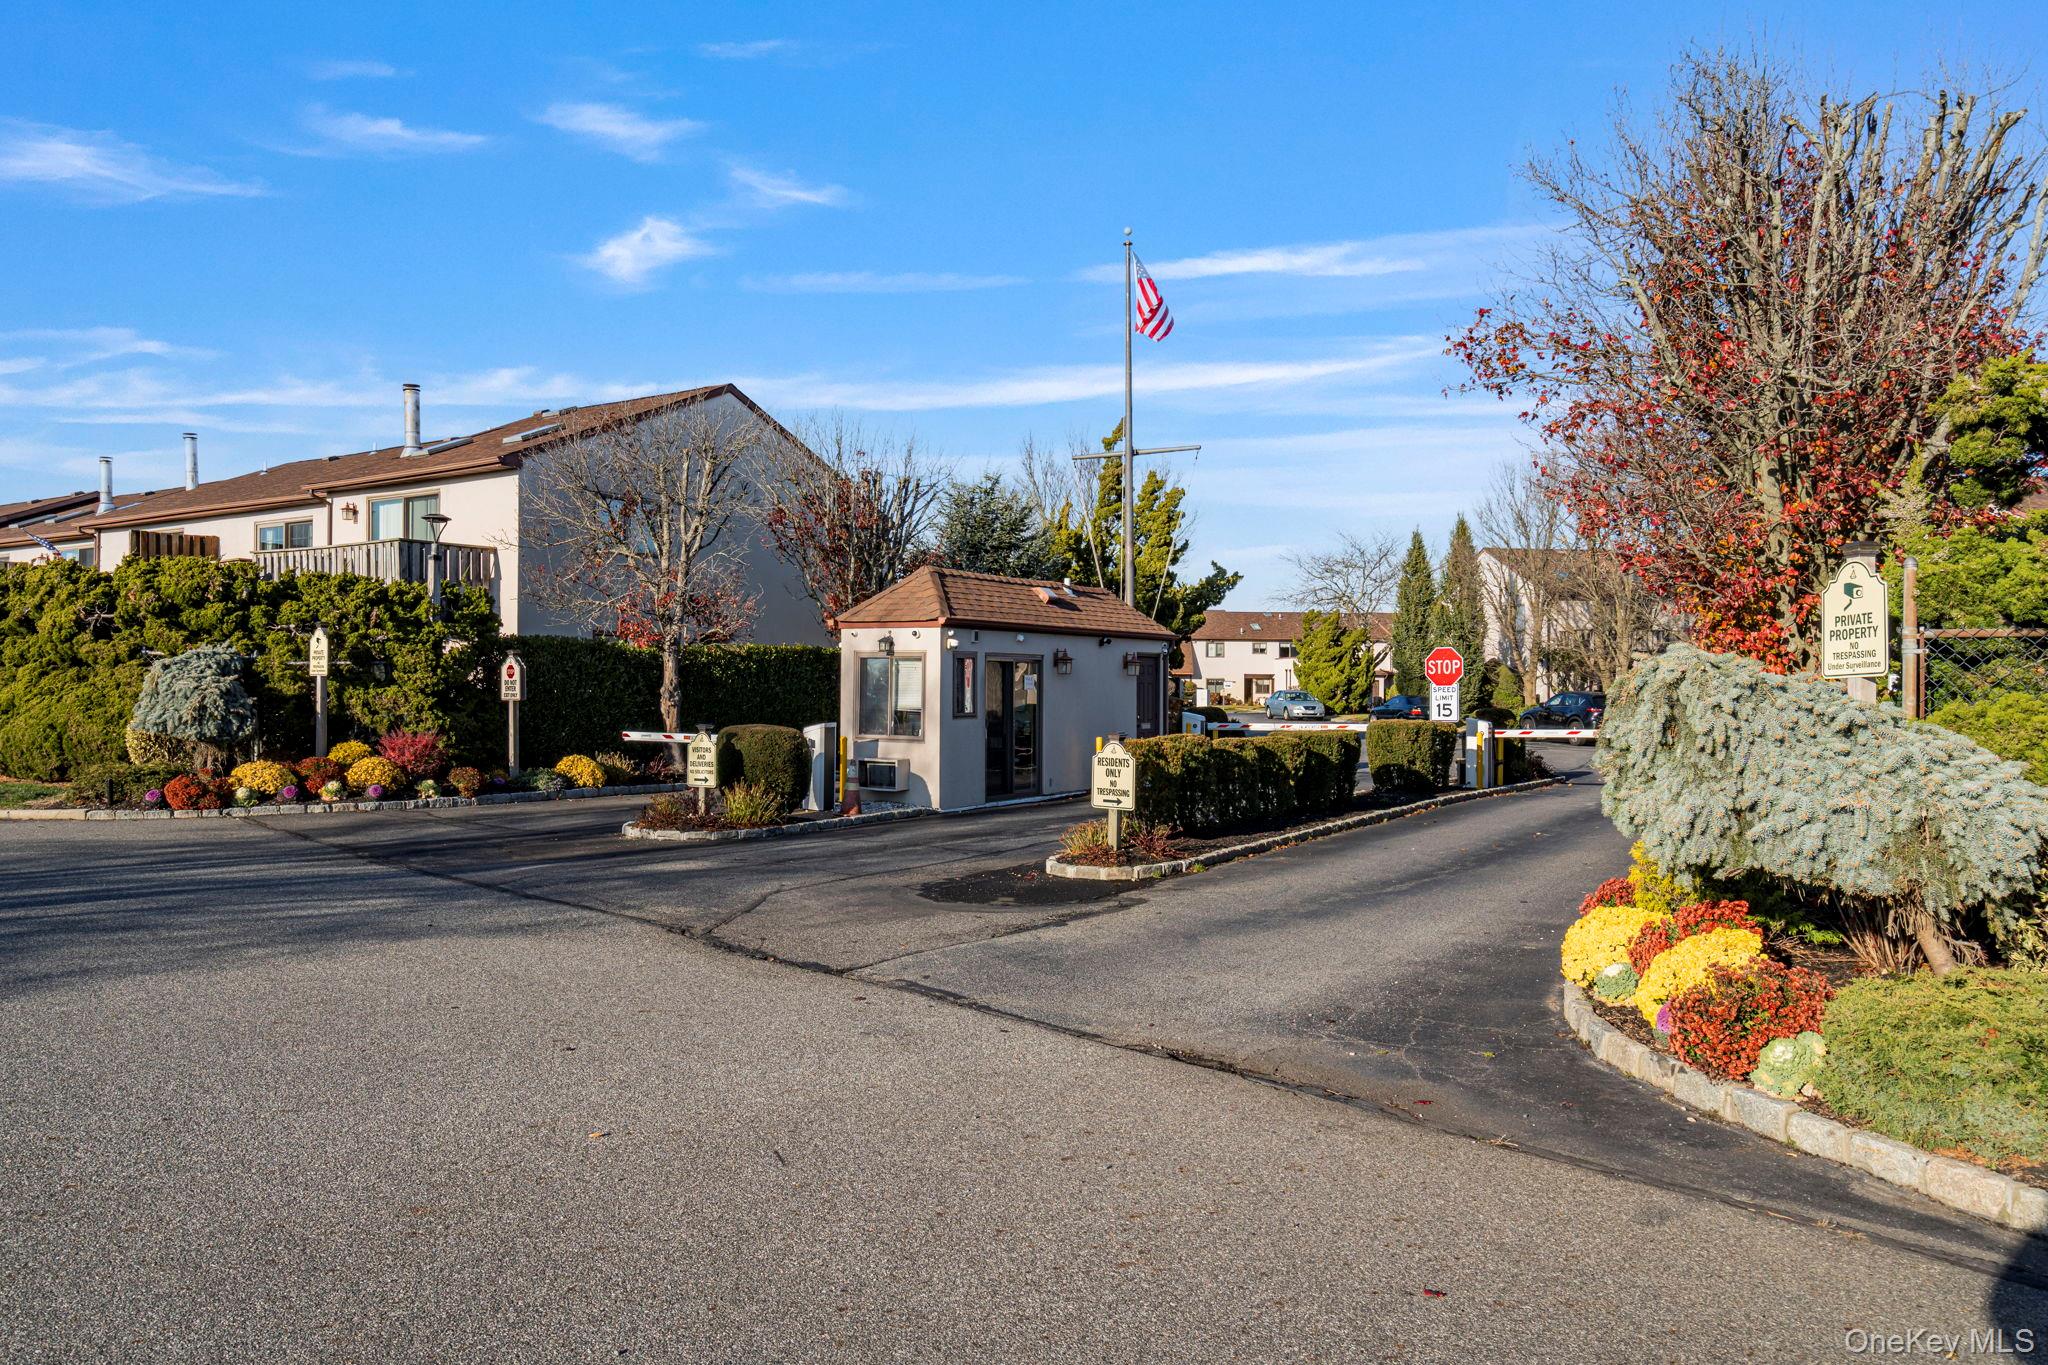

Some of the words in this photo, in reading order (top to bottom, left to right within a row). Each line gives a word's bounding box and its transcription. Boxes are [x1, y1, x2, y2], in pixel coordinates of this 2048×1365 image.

[1834, 612, 1873, 627] PRIVATE
[1829, 625, 1879, 641] PROPERTY
[1849, 642, 1859, 650] NO
[1832, 650, 1877, 660] TRESPASSING
[1427, 659, 1461, 675] STOP
[1827, 663, 1845, 671] Under
[1845, 660, 1882, 670] Surveillance
[1436, 703, 1453, 718] 15
[1097, 757, 1130, 768] RESIDENTS
[1105, 767, 1122, 778] ONLY
[1109, 780, 1118, 788] NO
[1096, 787, 1130, 798] TRESPASSING
